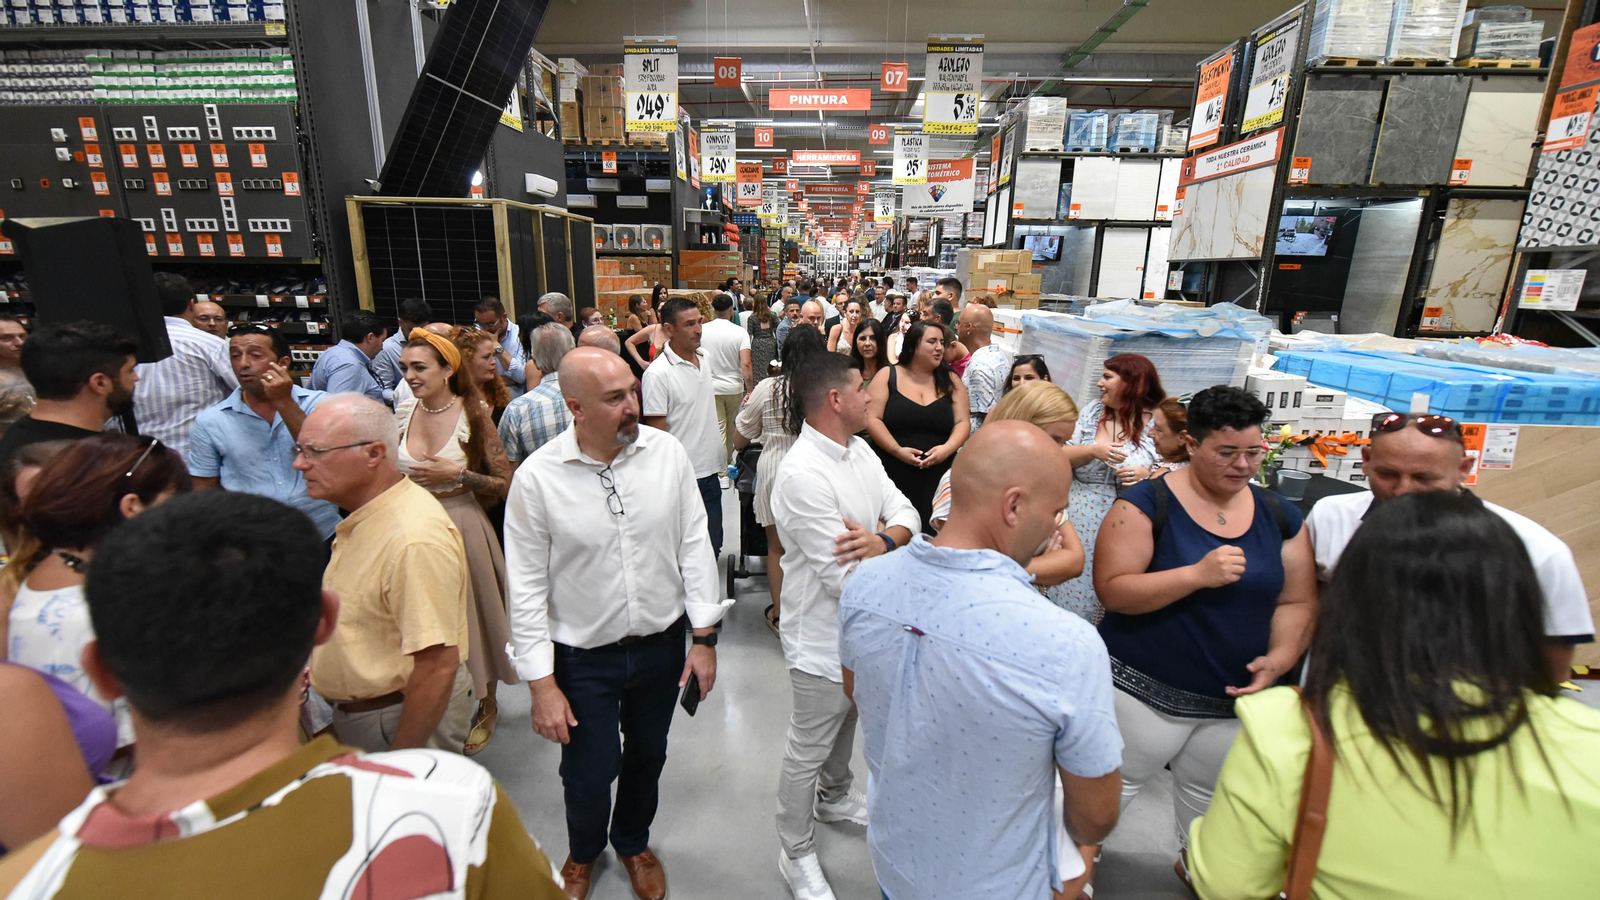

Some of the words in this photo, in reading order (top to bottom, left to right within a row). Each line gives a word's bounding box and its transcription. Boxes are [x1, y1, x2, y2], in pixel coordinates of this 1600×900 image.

[642, 58, 660, 72] SPLIT
[938, 57, 970, 72] AZULEJO
[718, 66, 737, 79] 08
[885, 71, 904, 84] 07
[789, 95, 848, 105] PINTURA
[758, 132, 770, 142] 10
[872, 130, 886, 140] 09
[1218, 149, 1239, 160] NUESTRA
[1240, 140, 1266, 154] CERÁMICA
[1224, 155, 1250, 169] CALIDAD
